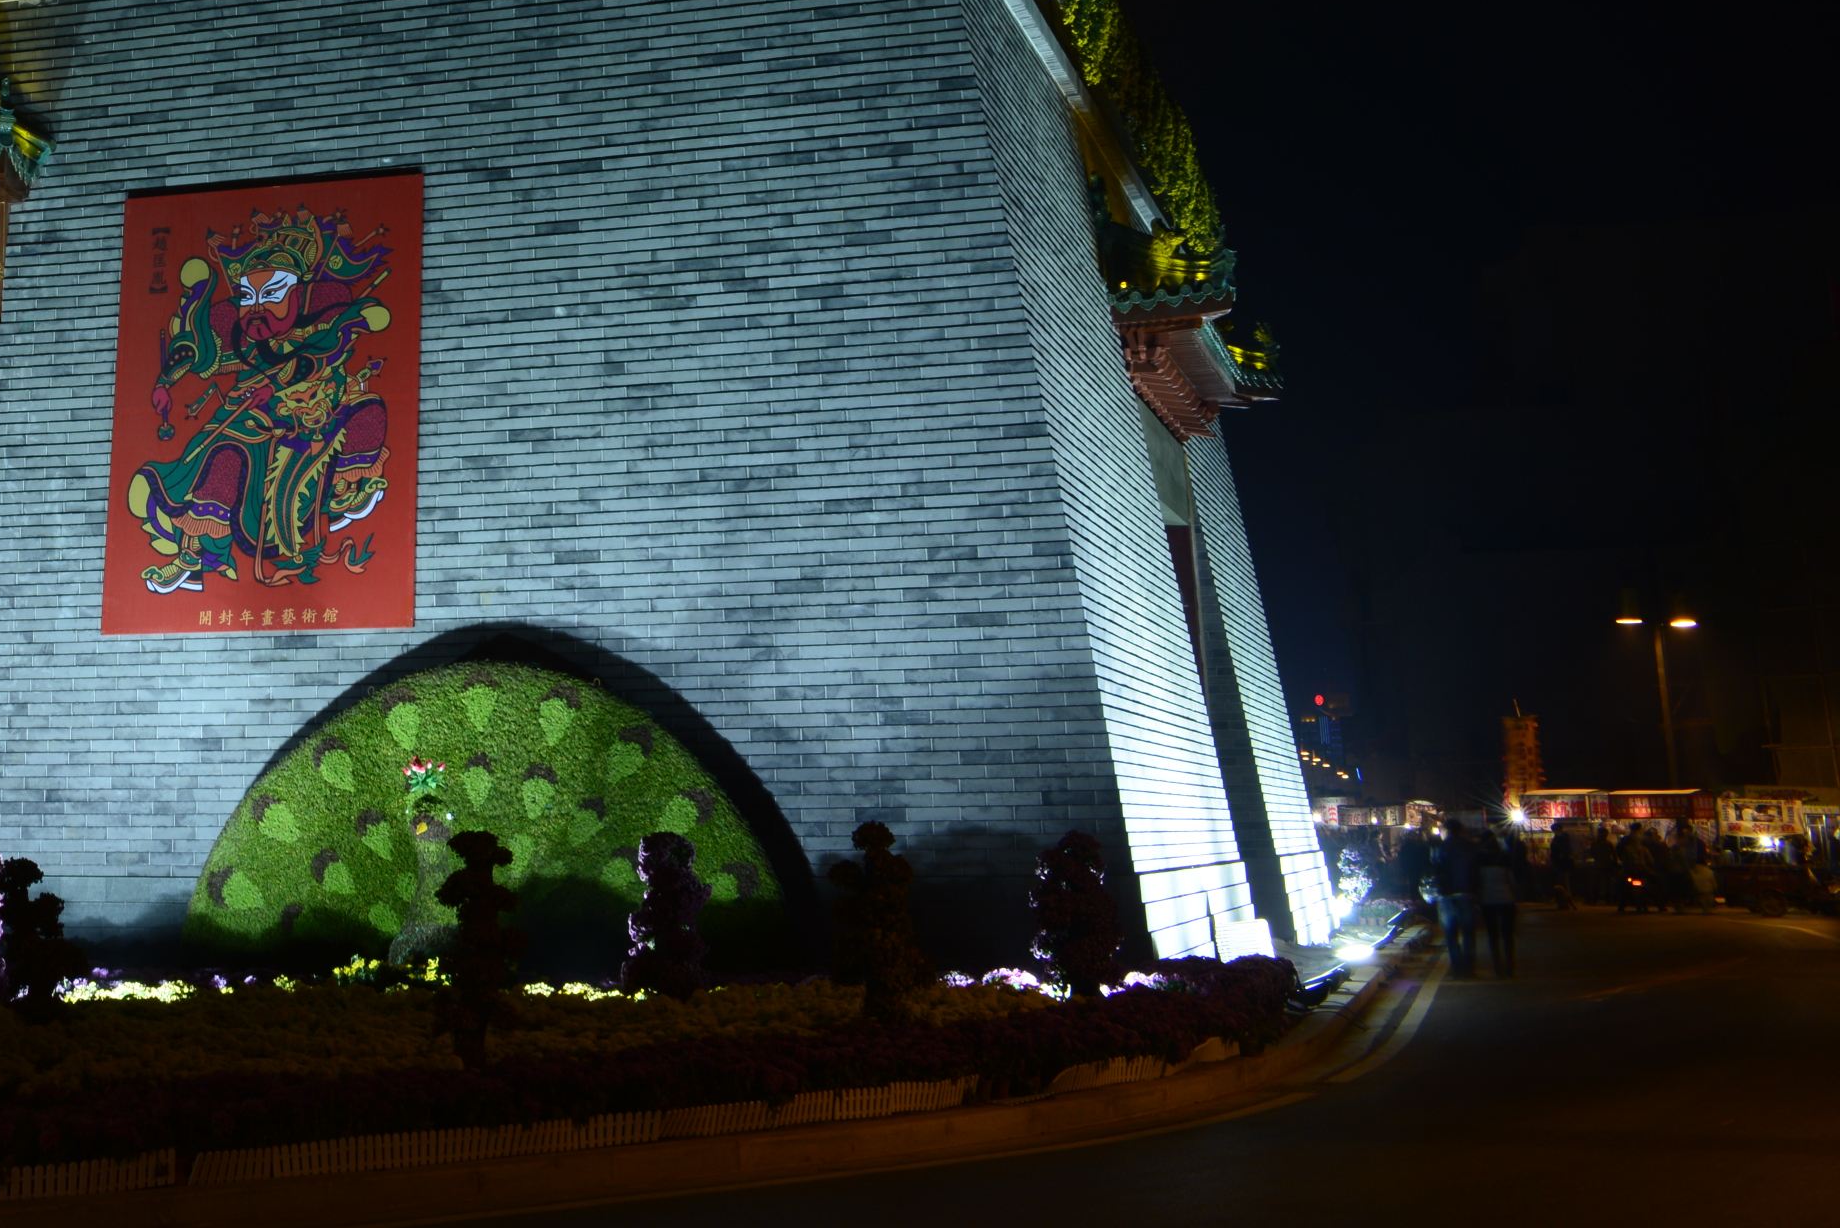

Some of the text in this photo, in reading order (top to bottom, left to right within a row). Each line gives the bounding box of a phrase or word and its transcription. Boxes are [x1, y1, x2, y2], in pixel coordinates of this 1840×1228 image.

[199, 607, 339, 626] 開封年畫藝術館
